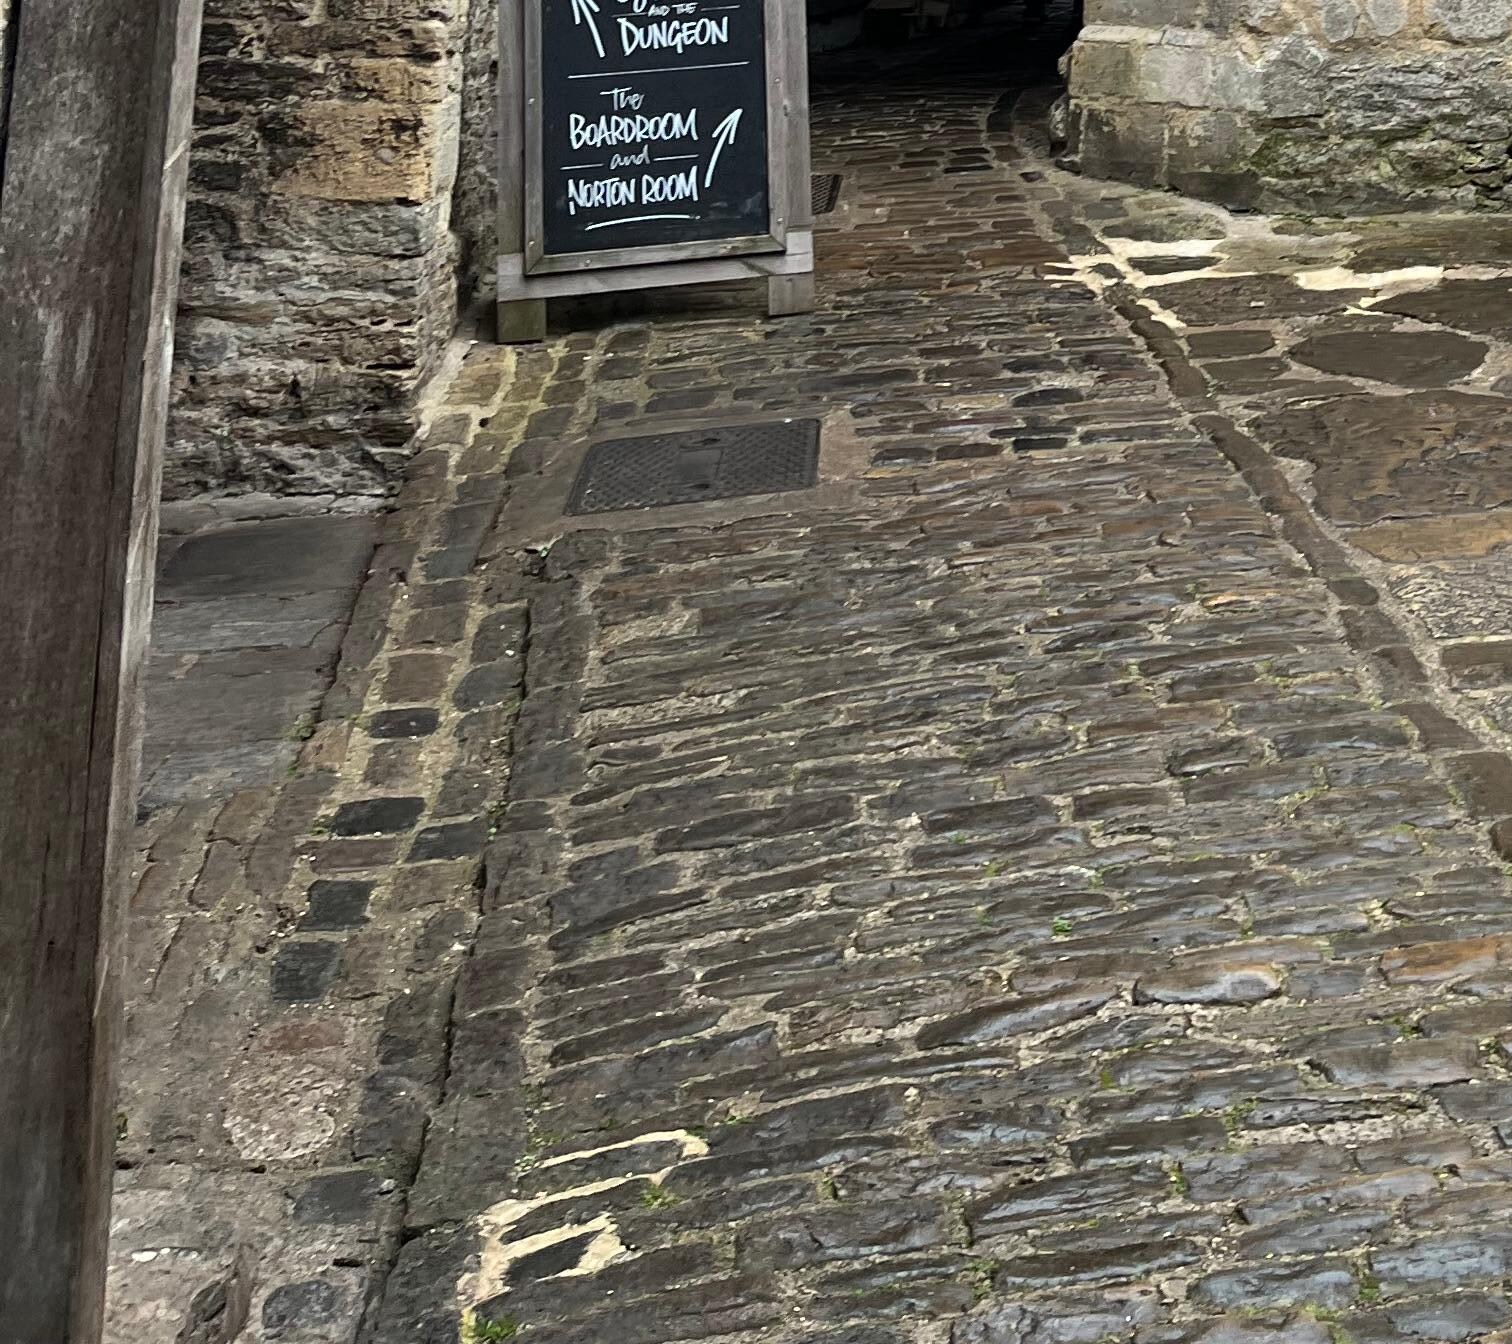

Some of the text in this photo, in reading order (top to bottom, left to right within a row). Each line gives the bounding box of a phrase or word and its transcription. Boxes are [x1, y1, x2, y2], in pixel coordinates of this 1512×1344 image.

[647, 2, 699, 17] AND THE
[617, 16, 729, 56] DUNGEON
[600, 87, 645, 110] The
[569, 108, 698, 150] BOARDROOM
[609, 144, 651, 170] and
[568, 165, 698, 215] NORTON ROOM
